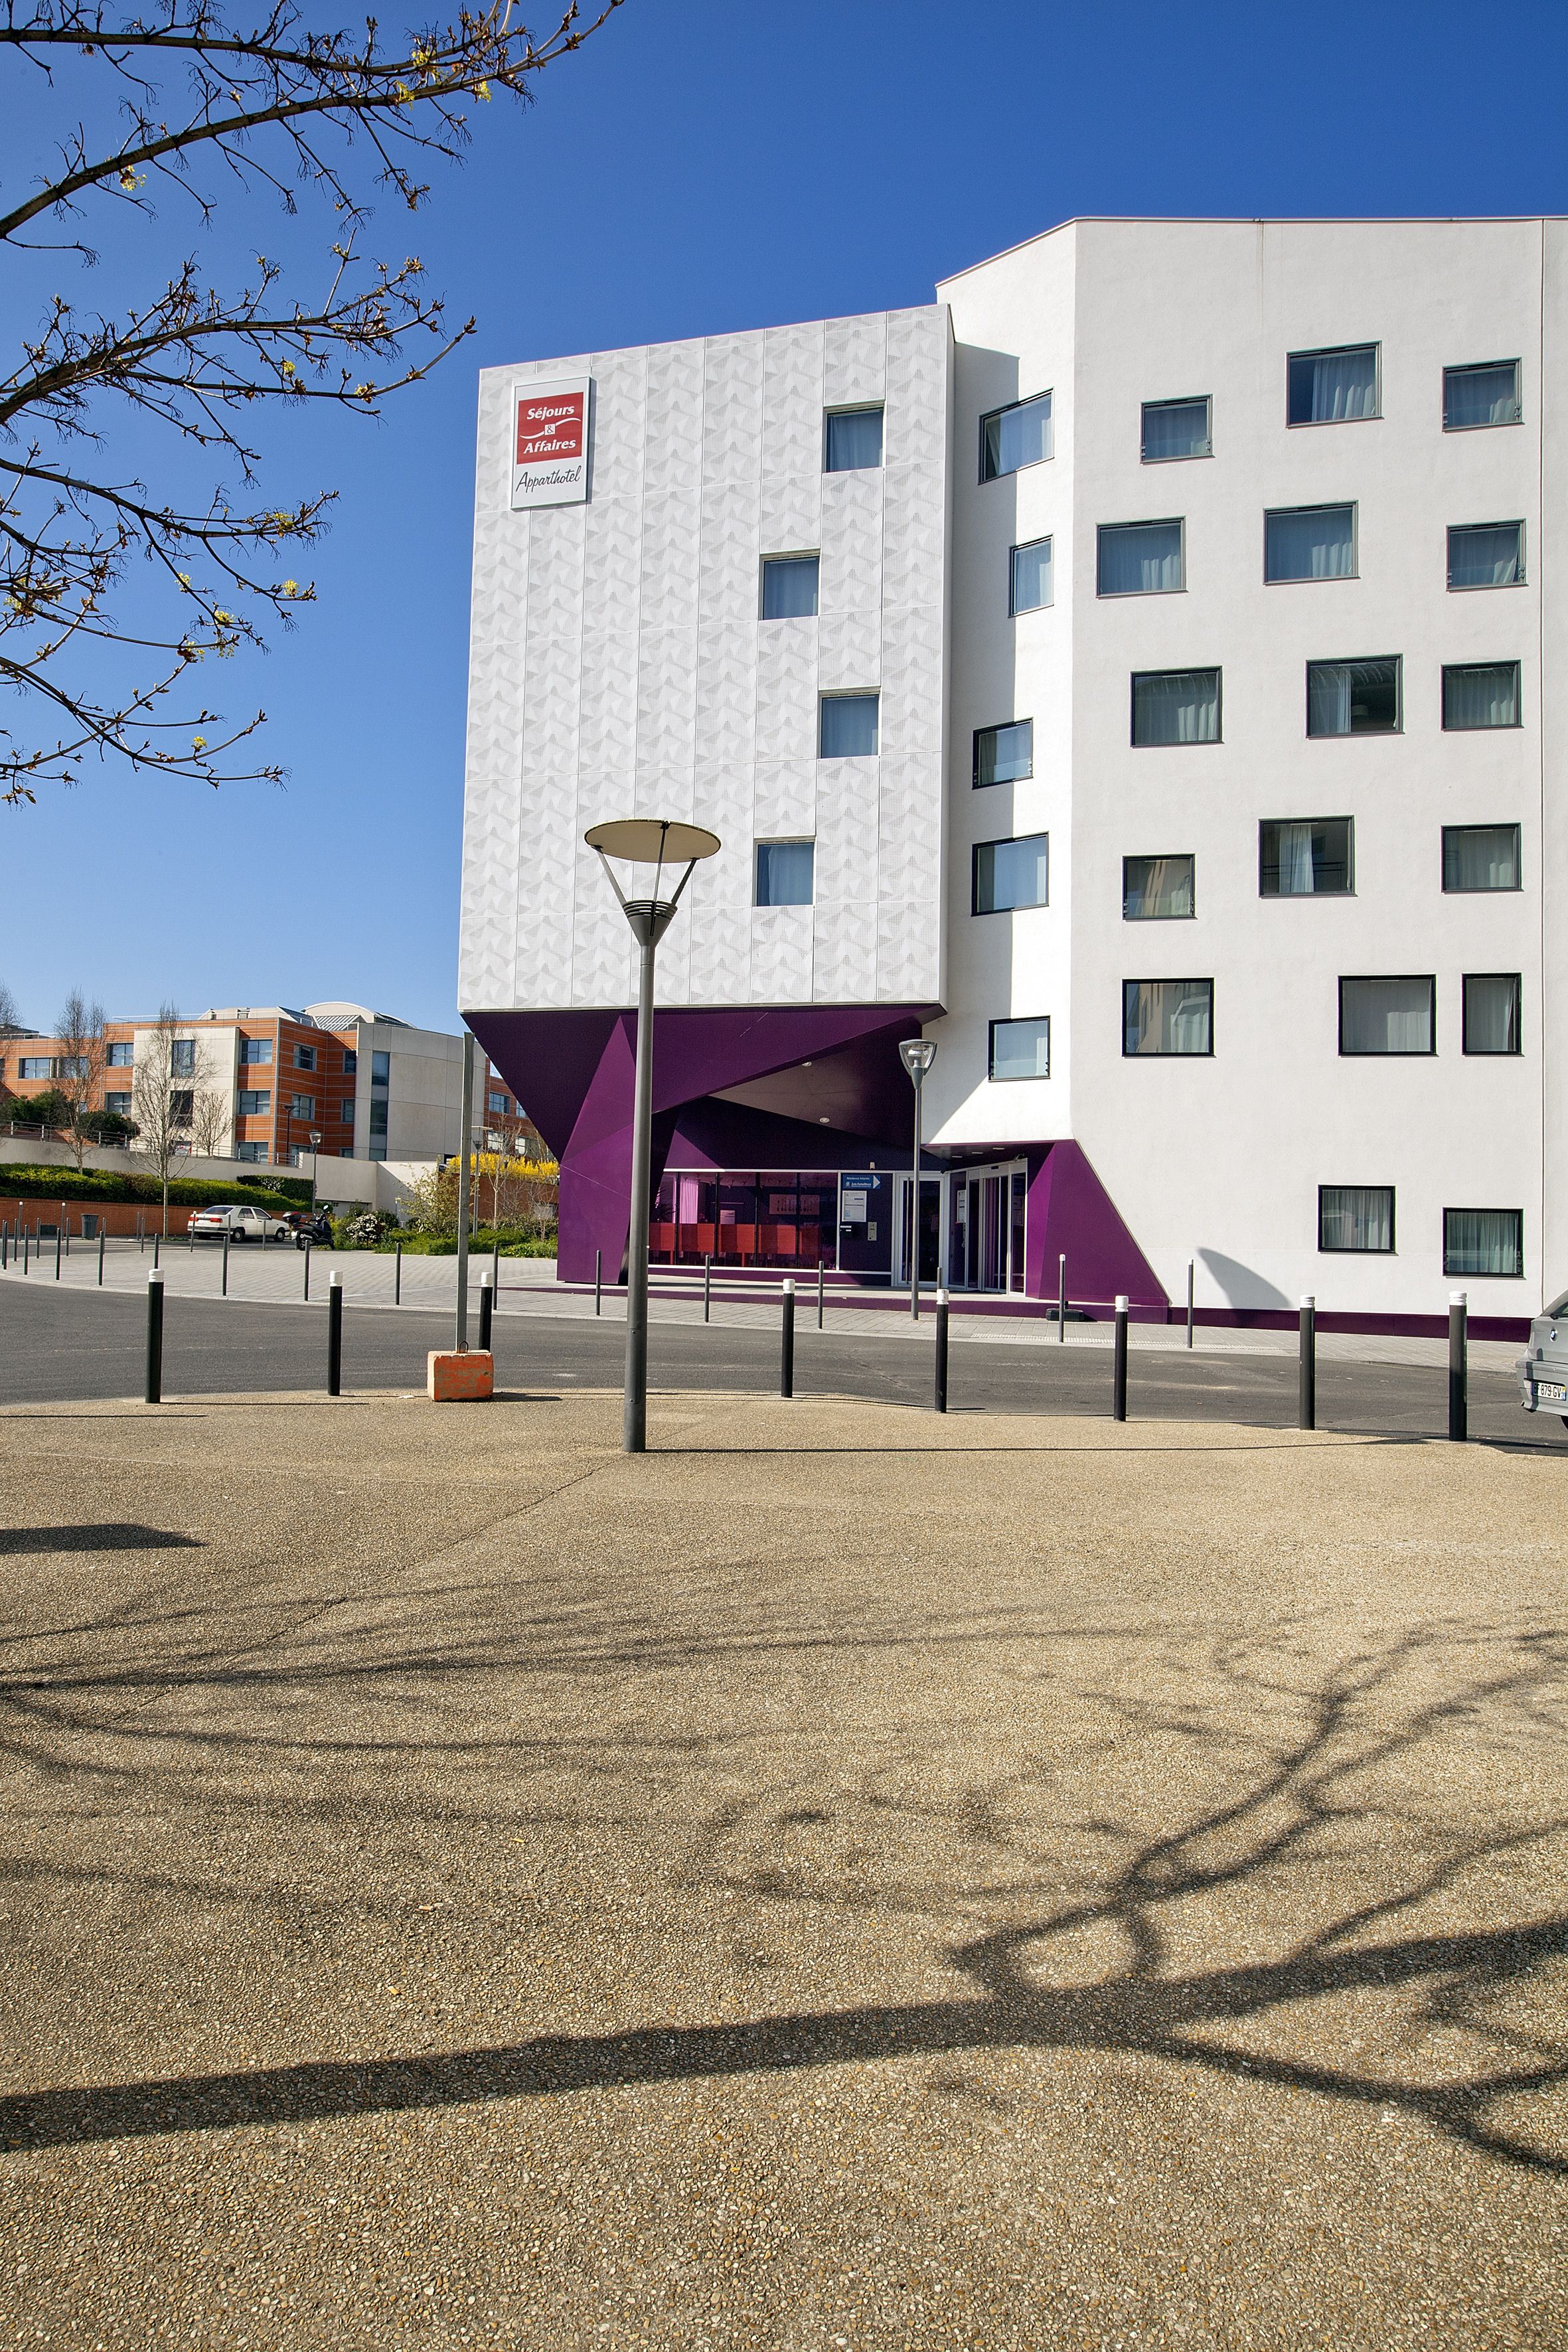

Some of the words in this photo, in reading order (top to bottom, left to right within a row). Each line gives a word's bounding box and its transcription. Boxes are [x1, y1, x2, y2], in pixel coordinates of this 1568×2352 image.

[526, 406, 574, 421] Séjours
[546, 425, 554, 433] &
[523, 439, 576, 454] Affaires
[515, 465, 582, 493] Apparthotel
